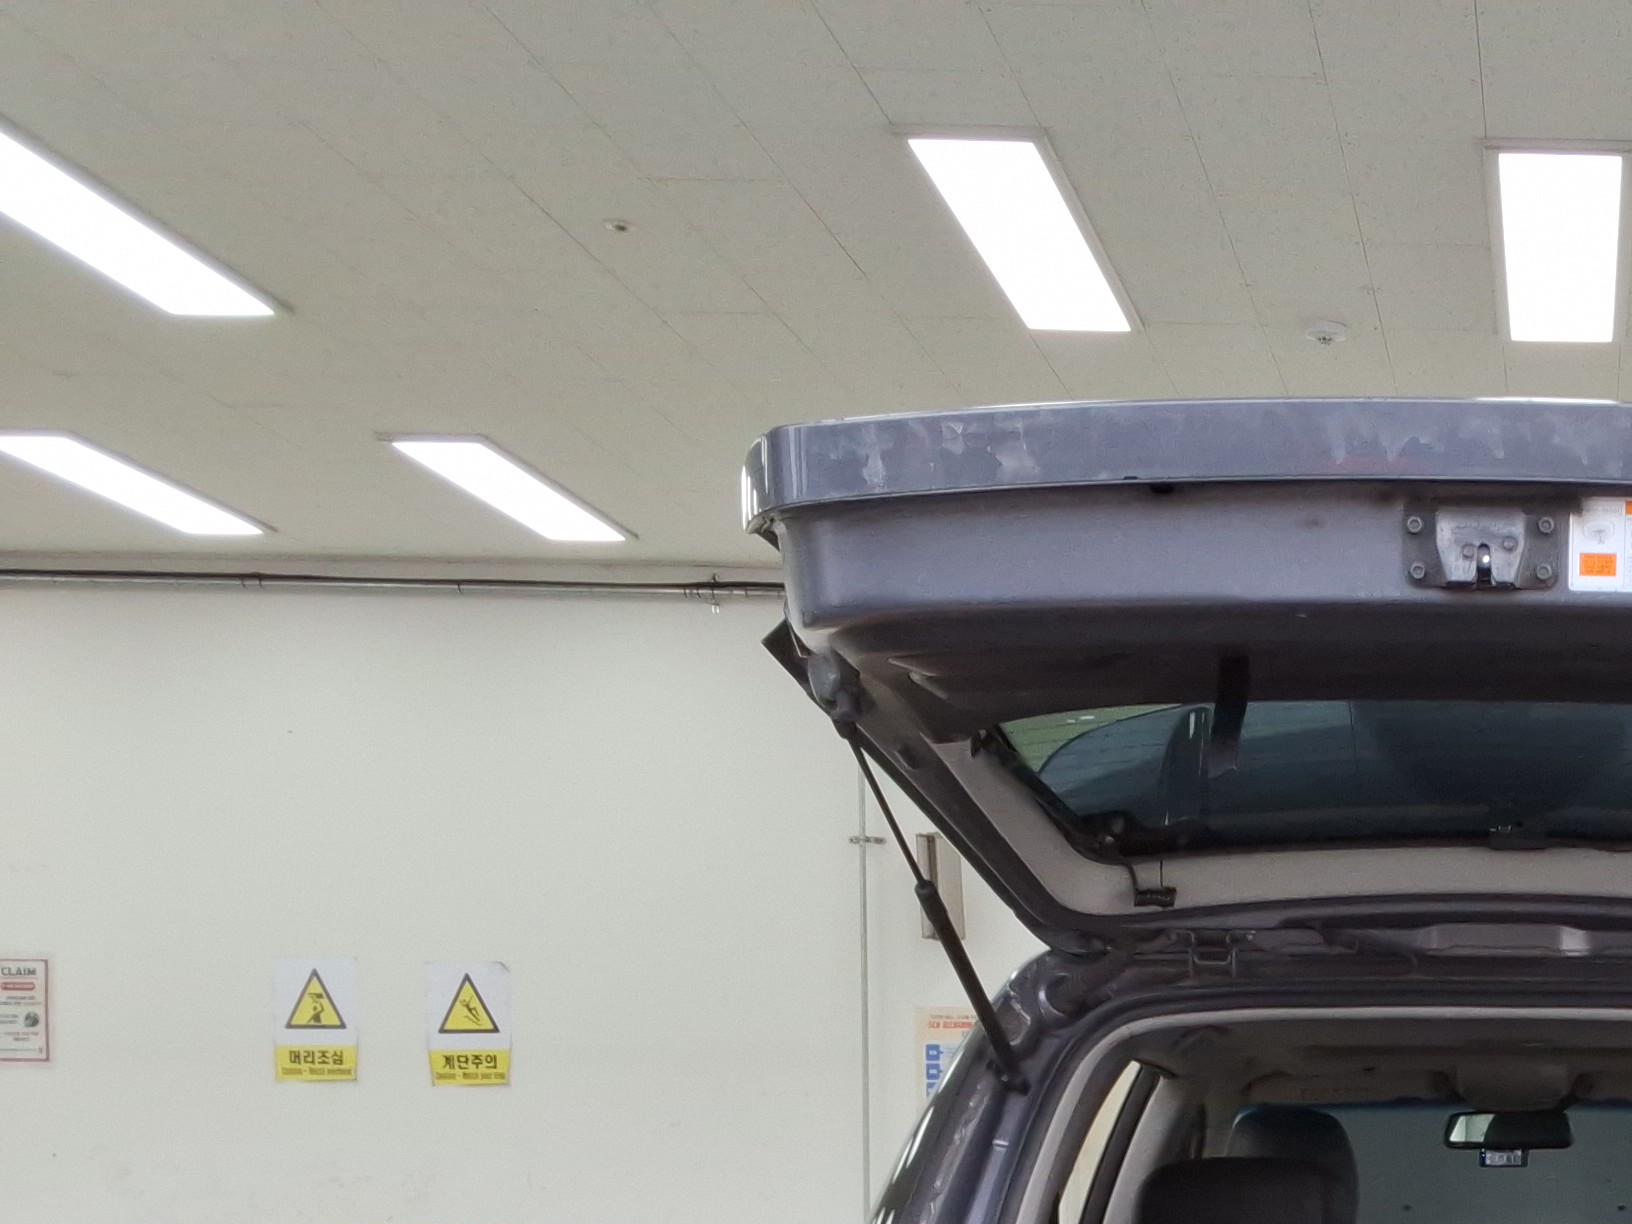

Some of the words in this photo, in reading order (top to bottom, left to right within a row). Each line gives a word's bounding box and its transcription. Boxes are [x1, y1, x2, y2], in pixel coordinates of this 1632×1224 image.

[0, 967, 36, 976] CLAIM
[288, 1049, 344, 1066] 머리조심
[442, 1054, 498, 1070] 계단주의
